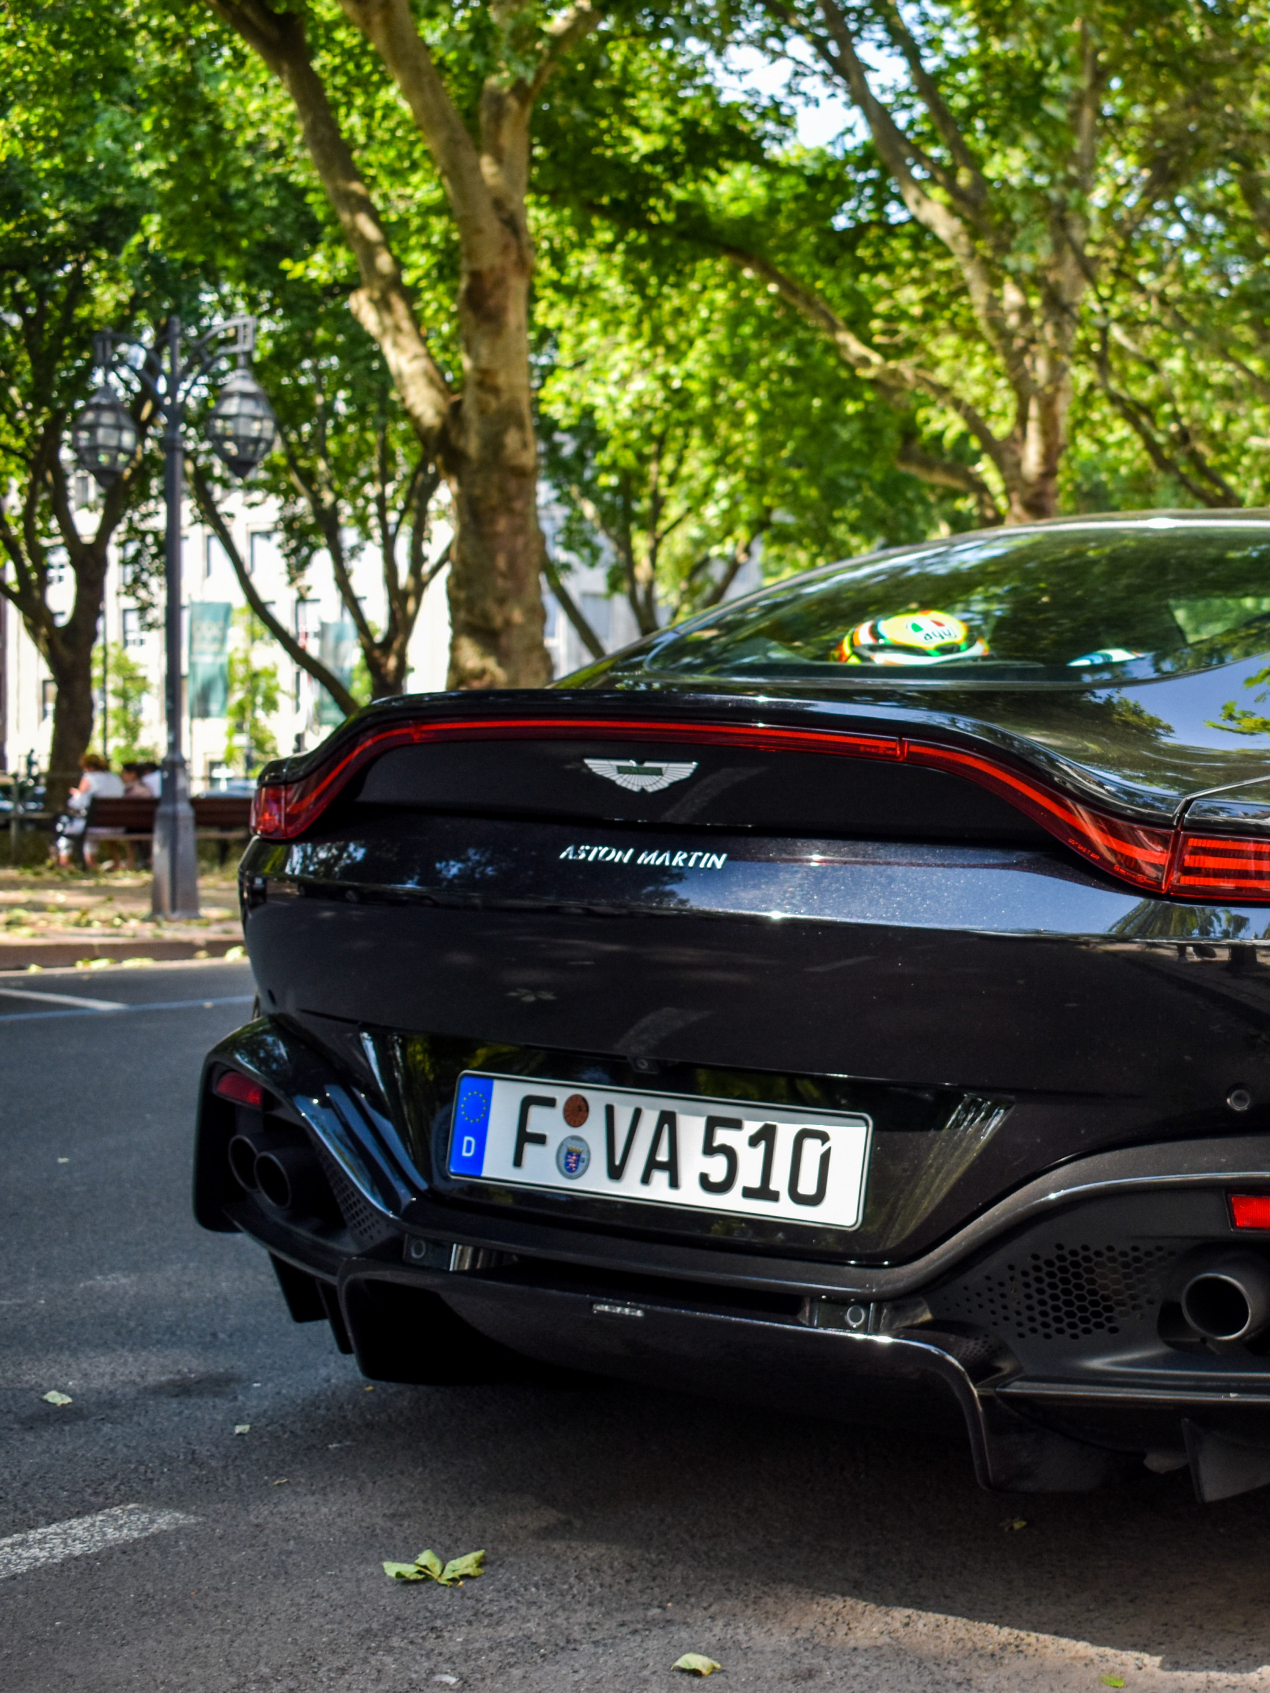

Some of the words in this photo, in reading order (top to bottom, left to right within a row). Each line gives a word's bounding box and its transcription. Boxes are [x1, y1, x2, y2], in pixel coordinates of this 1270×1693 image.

[559, 844, 635, 864] ASTON
[636, 849, 728, 870] MARTIN
[462, 1135, 476, 1158] D
[512, 1094, 557, 1168] F
[698, 1114, 832, 1207] 510
